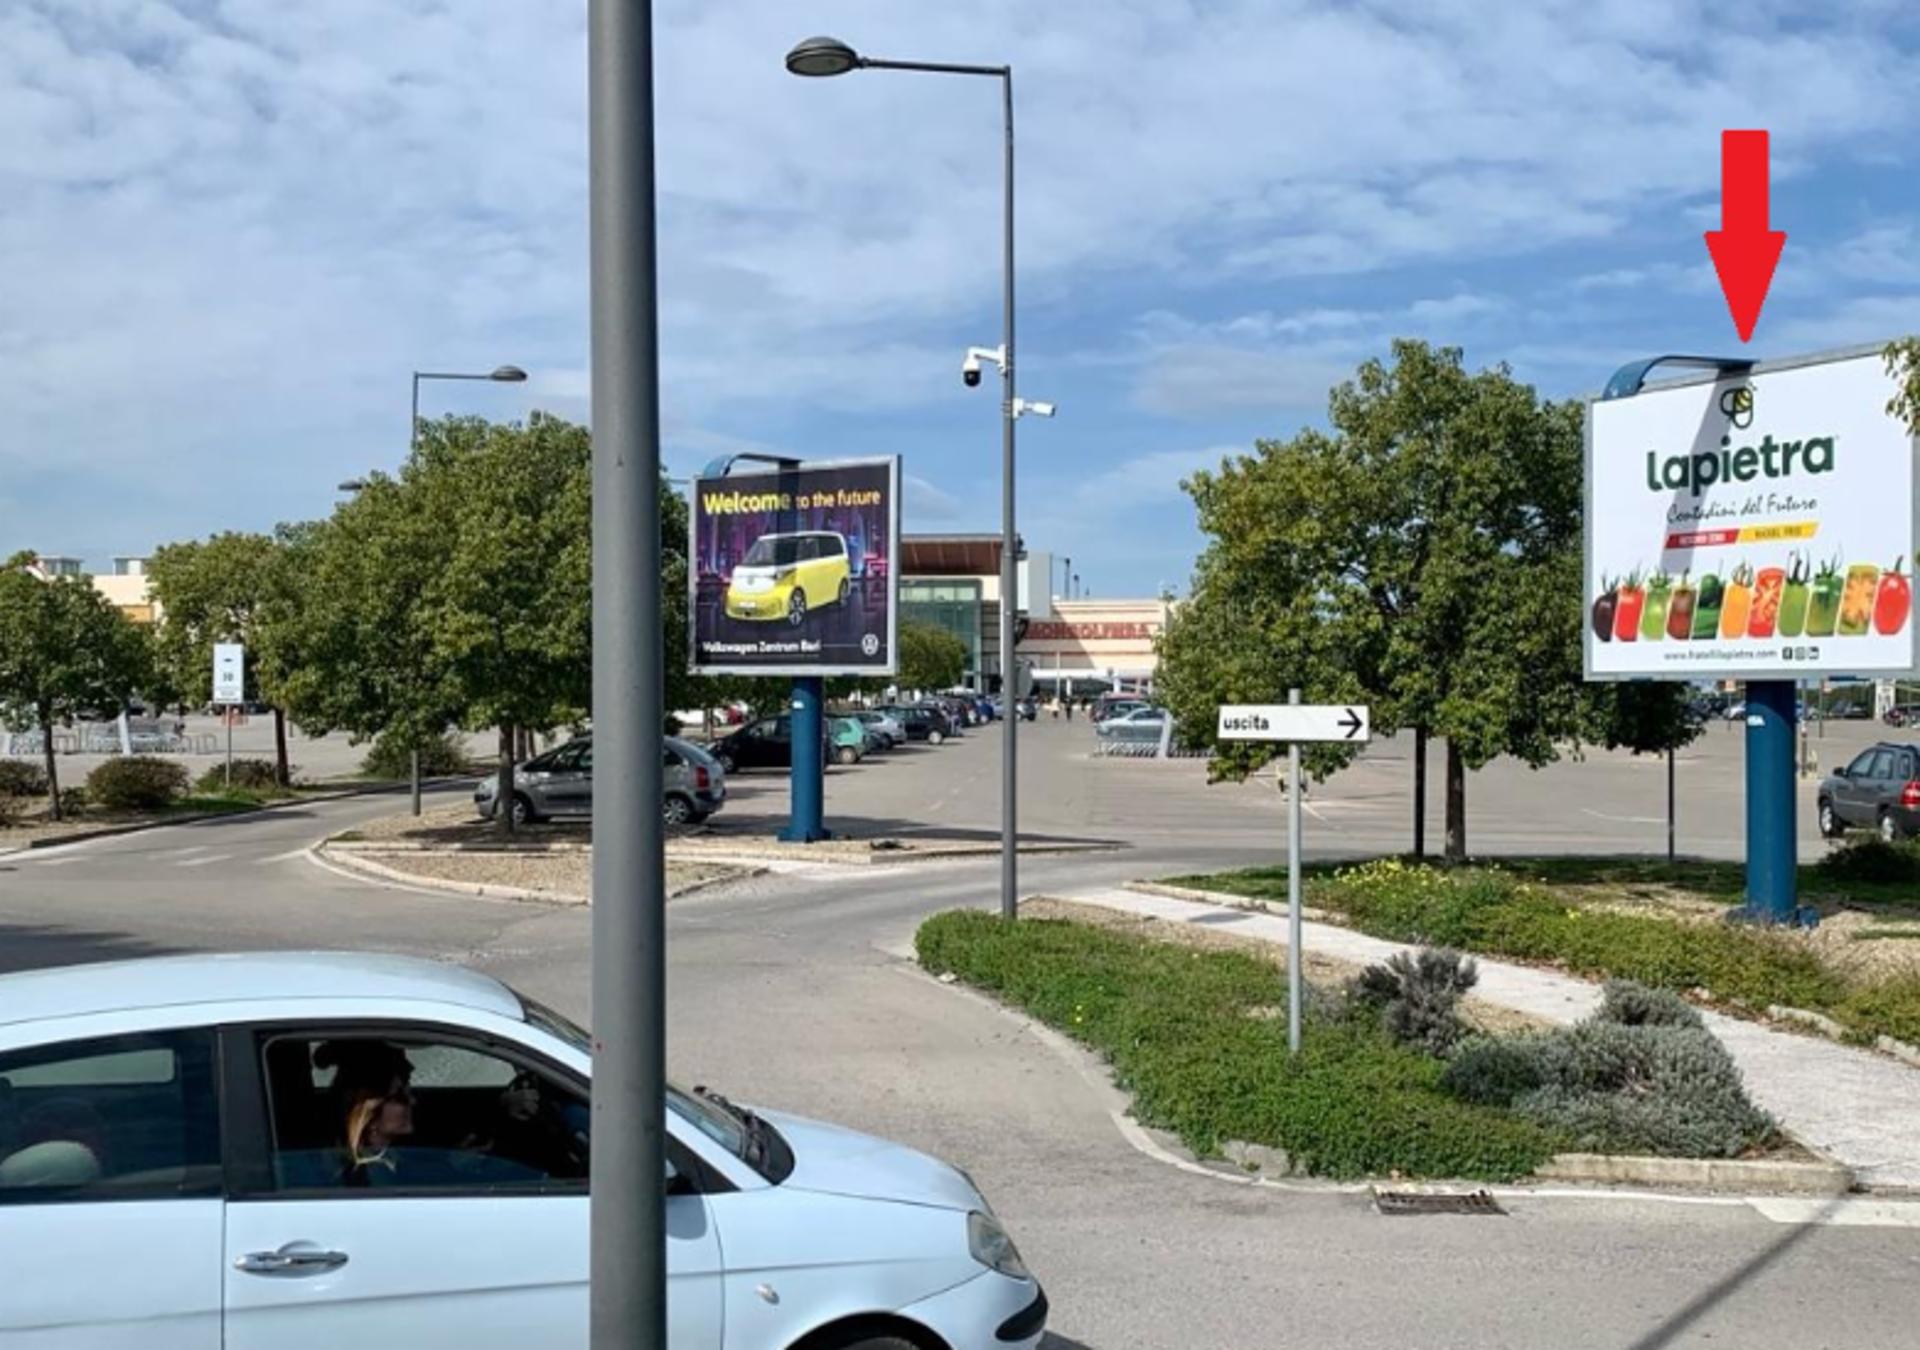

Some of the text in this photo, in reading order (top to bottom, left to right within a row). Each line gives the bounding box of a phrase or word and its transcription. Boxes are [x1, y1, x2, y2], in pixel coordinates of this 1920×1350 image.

[1648, 435, 1834, 496] lapietra
[703, 489, 881, 515] Welcome to the future
[1667, 501, 1736, 523] Contadini
[1741, 494, 1761, 515] del
[703, 641, 757, 655] Volkswagen
[760, 641, 798, 653] Zentrum
[1223, 714, 1269, 731] uscita
